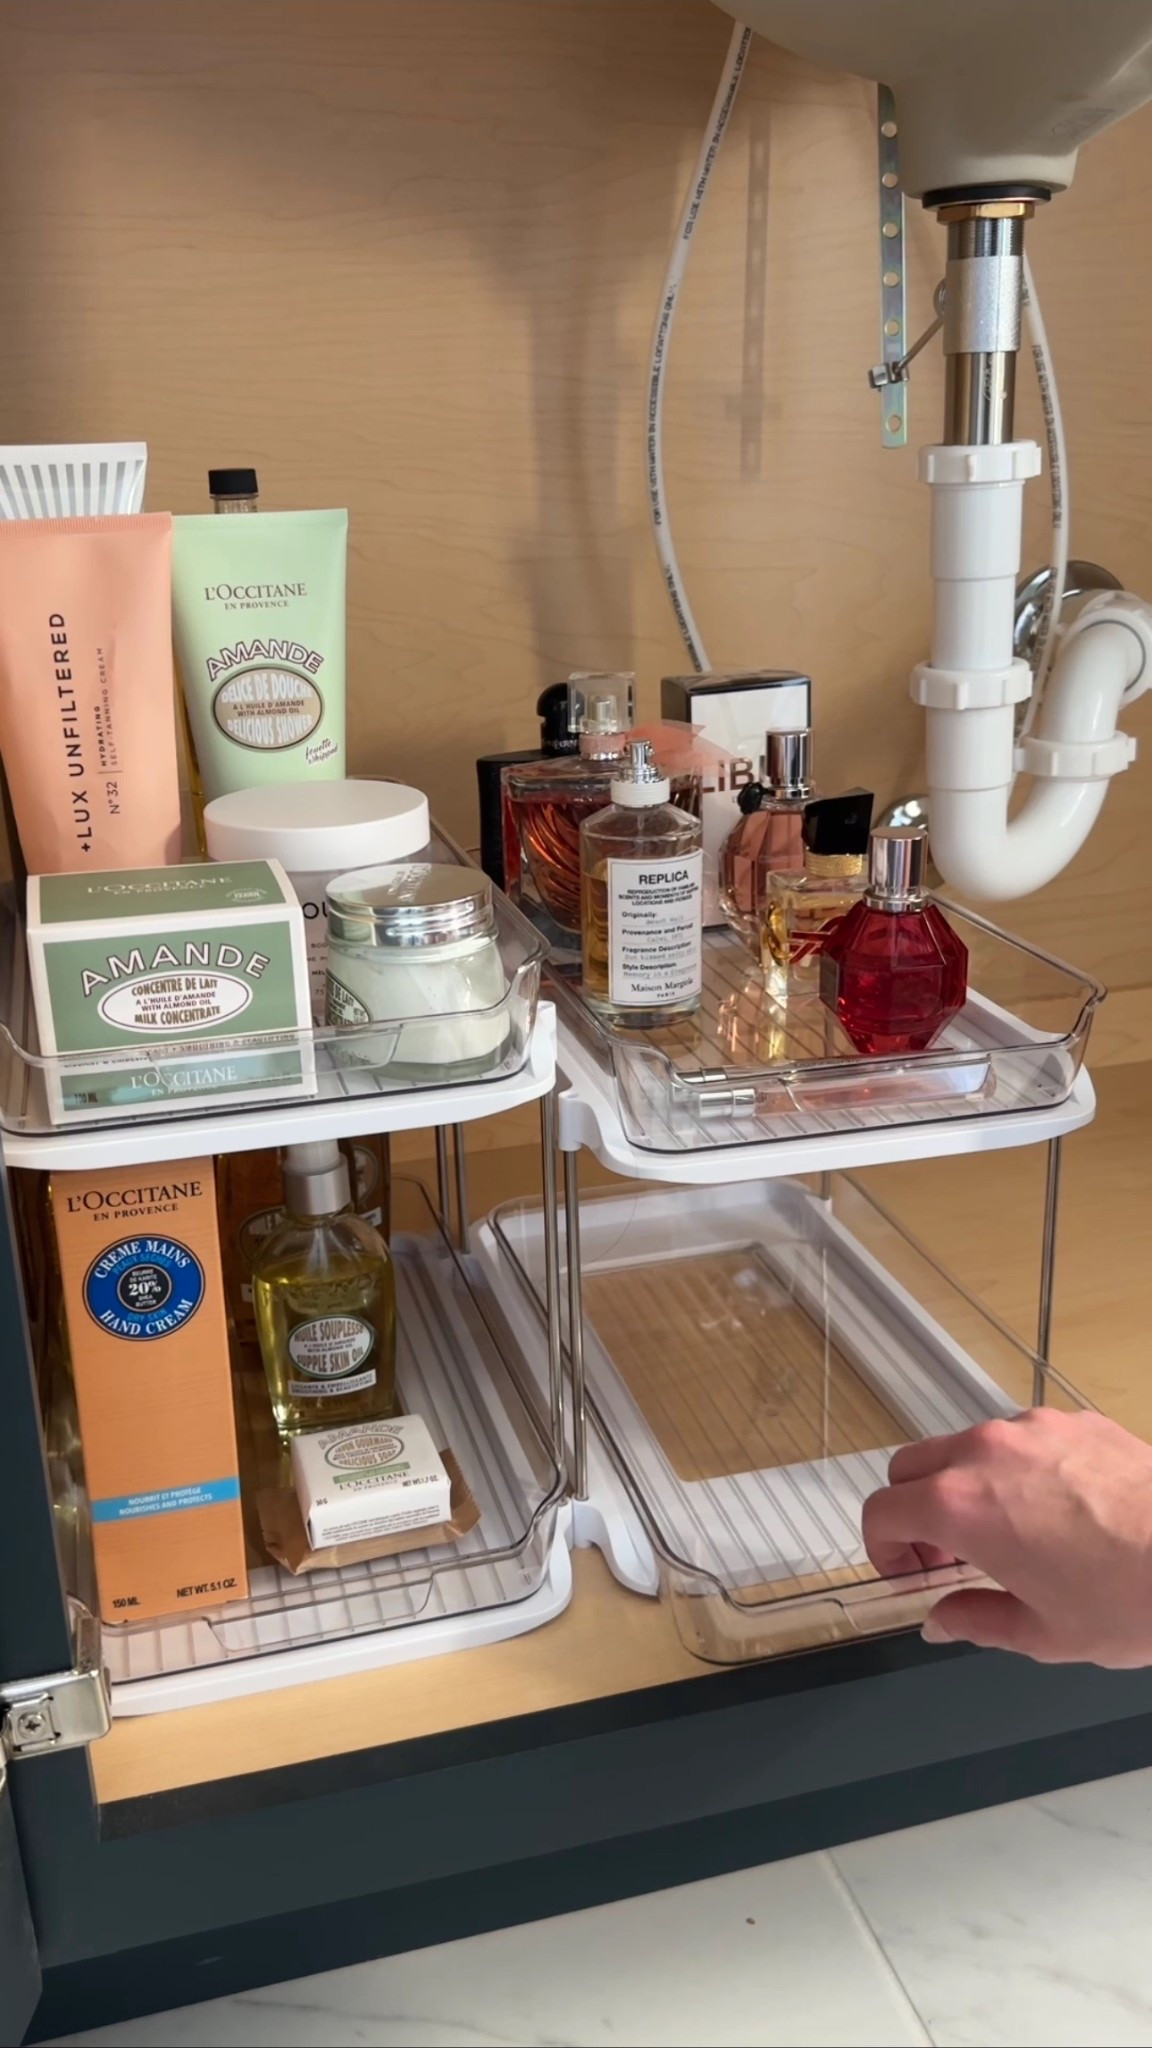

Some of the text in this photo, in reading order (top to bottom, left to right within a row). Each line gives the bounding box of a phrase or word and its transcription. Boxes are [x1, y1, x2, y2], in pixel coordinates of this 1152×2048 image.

[204, 583, 307, 601] L'OCCITANE
[224, 600, 289, 611] EN PROVENCE
[97, 648, 107, 684] CREAM
[206, 639, 325, 682] AMANDE
[49, 613, 85, 777] UNFILTERED
[254, 674, 269, 701] DE
[271, 673, 312, 700] DOUCHE
[93, 706, 106, 767] HYDRATING
[227, 714, 312, 745] DELICIOUS SHOWER
[87, 877, 232, 894] L'OCCITANE
[639, 870, 689, 885] REPLICA
[622, 928, 662, 936] Provenance
[622, 946, 657, 954] Fragrance
[80, 942, 271, 998] AMANDE
[622, 963, 638, 971] Style
[132, 977, 218, 997] CONCENTRE DE LAIT
[631, 983, 662, 992] Maison
[141, 1003, 162, 1012] WITH
[163, 1001, 197, 1010] ALMOND
[144, 995, 172, 1004] L'HUILE
[175, 991, 216, 1001] D'AMANDE
[135, 1006, 221, 1025] MILK CONCENTRATE
[131, 1066, 237, 1089] L'OCCITANE
[66, 1181, 203, 1213] L'OCCITANE
[94, 1203, 179, 1221] EN PROVENCE
[94, 1240, 191, 1279] CREME MAINS
[128, 1280, 162, 1296] 20%
[135, 1299, 157, 1308] BUTTER
[99, 1298, 194, 1335] HAND CREAM
[127, 1308, 168, 1322] DRY SKIN
[320, 1321, 363, 1341] SOUPLESSE
[296, 1346, 363, 1372] SUPPLE SKIN OIL
[318, 1424, 404, 1450] AMANDE
[379, 1449, 396, 1461] SOAP
[339, 1471, 410, 1490] L'OCCITANE
[119, 1493, 212, 1515] NOURISHES AND PROTECTS
[128, 1493, 160, 1506] NOURRIT
[161, 1492, 170, 1500] ET
[176, 1586, 193, 1598] NET
[210, 1582, 222, 1592] 5.1
[112, 1598, 127, 1608] 150
